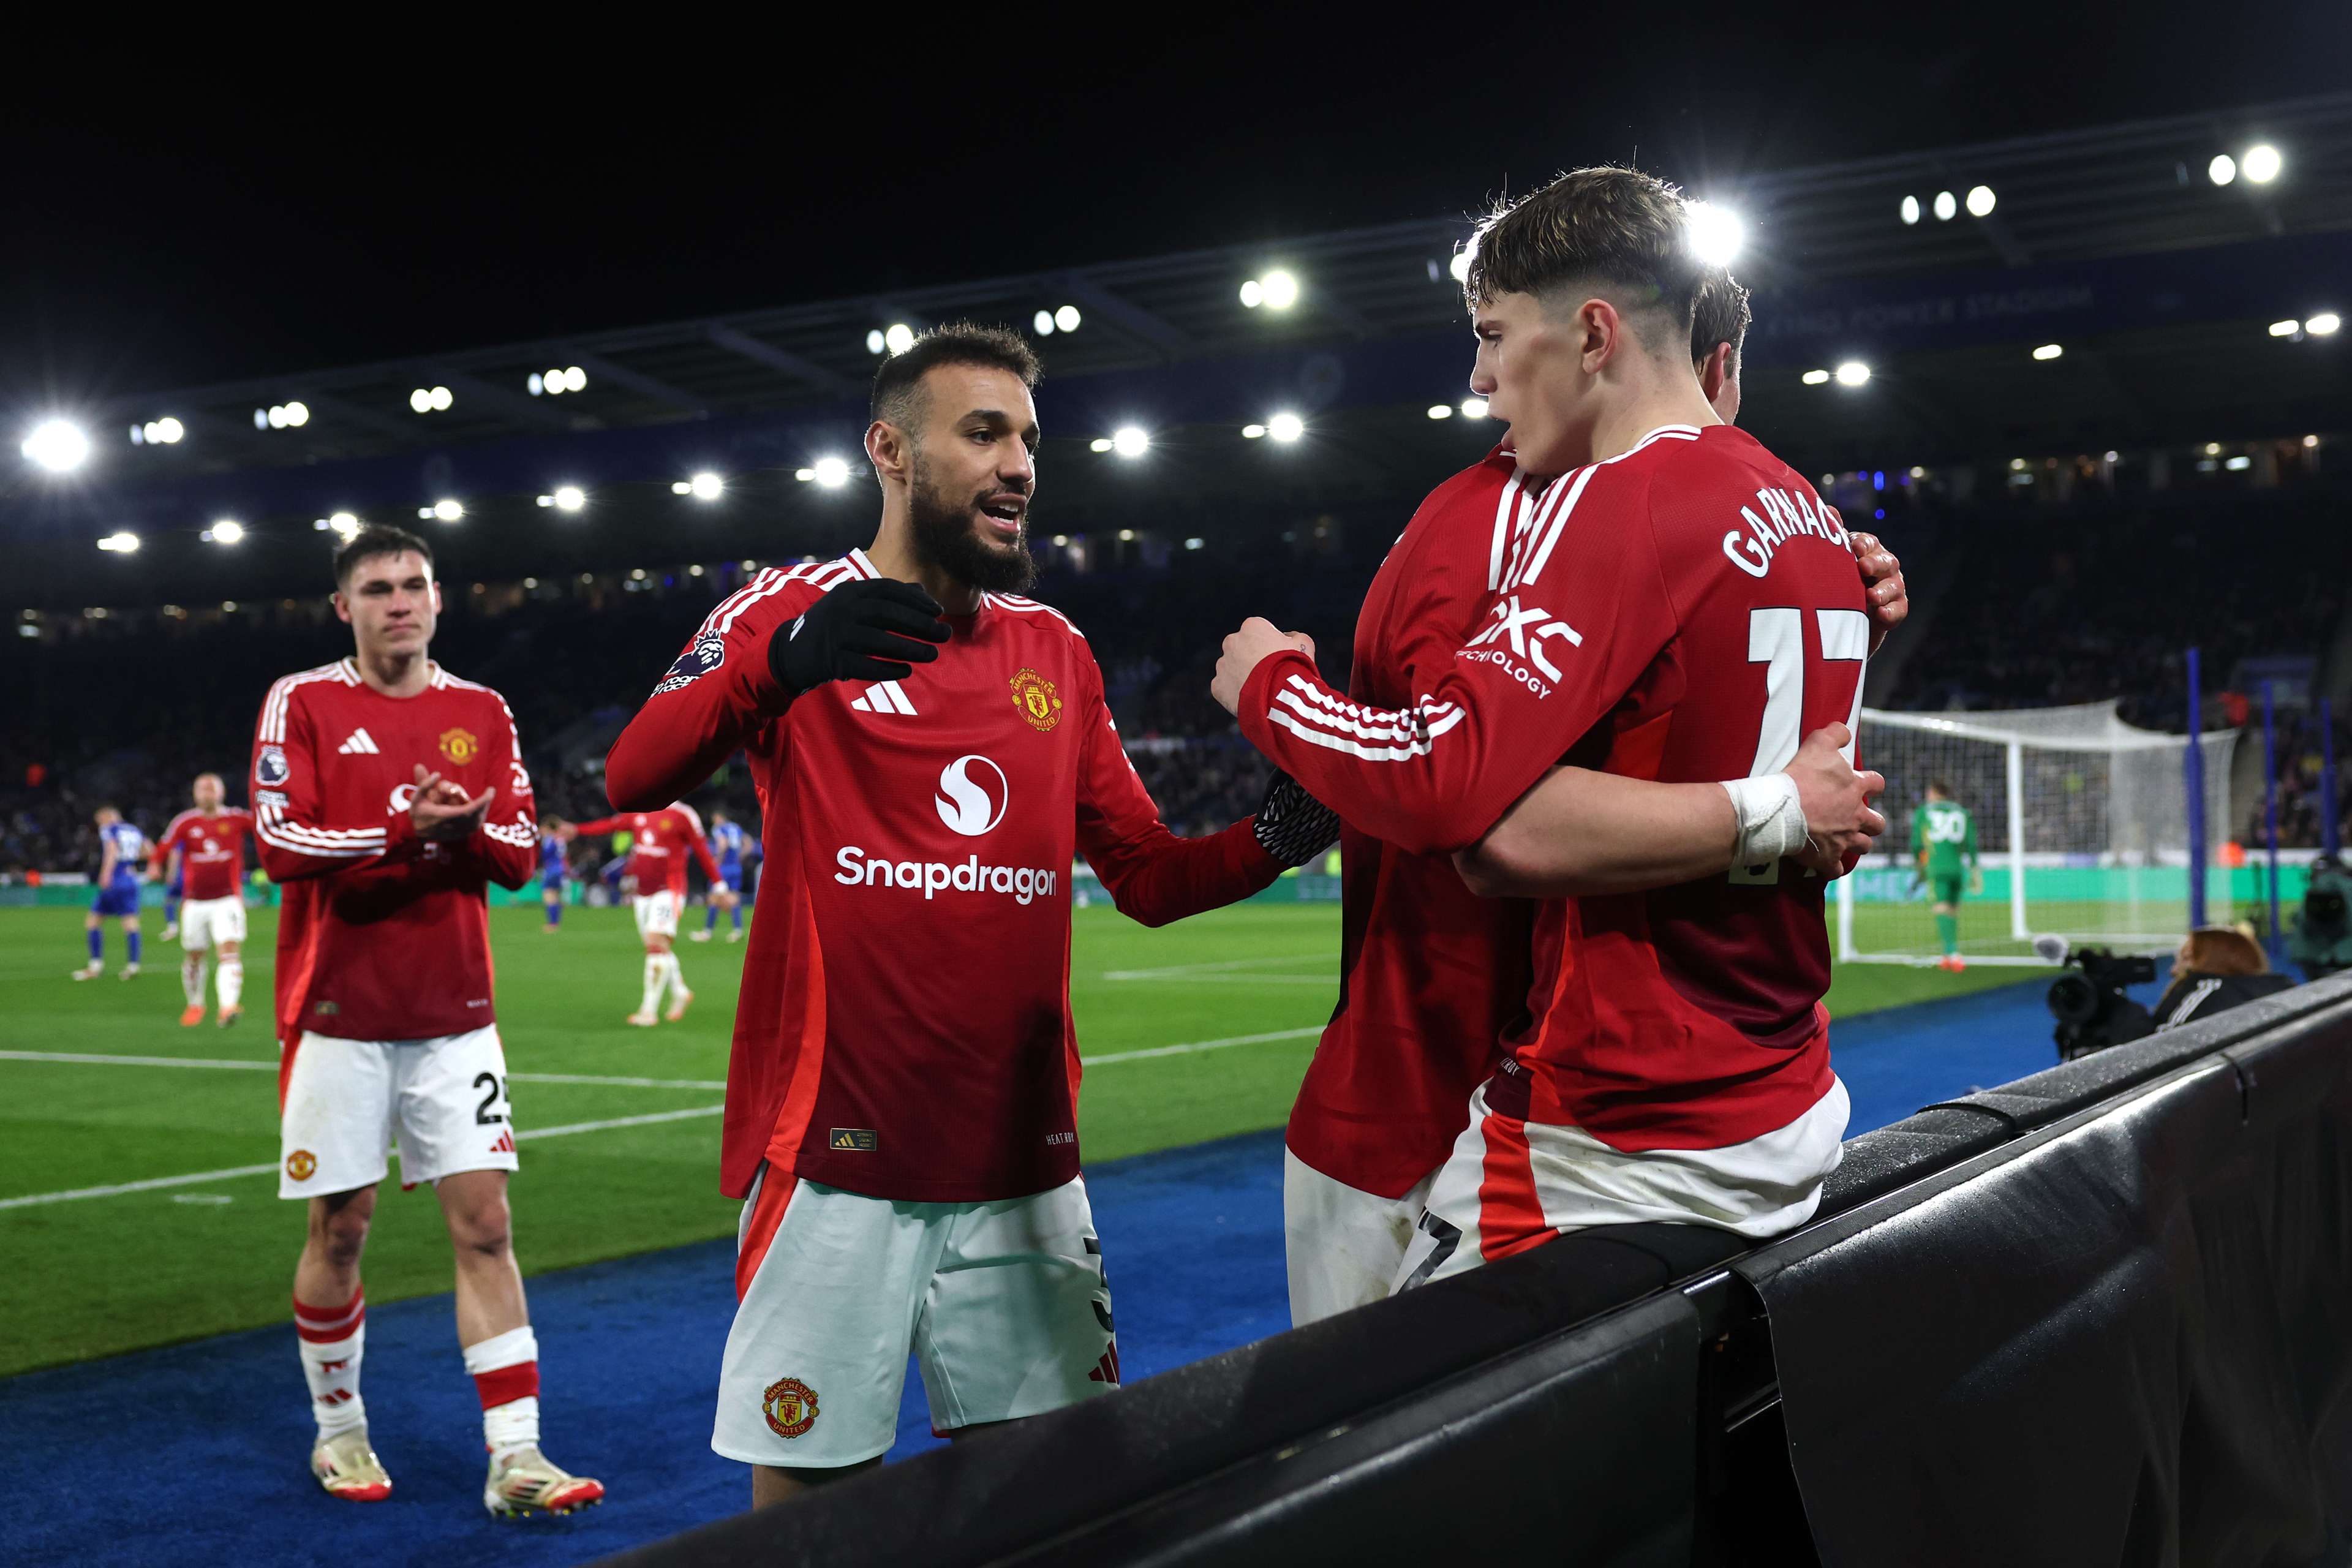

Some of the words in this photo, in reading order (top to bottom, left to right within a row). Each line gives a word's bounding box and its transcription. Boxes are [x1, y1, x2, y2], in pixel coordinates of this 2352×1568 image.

[1012, 672, 1053, 698] MANCHESTER
[1748, 606, 1869, 778] 17
[1027, 715, 1055, 726] UNITED
[1926, 810, 1966, 843] 30
[834, 846, 1057, 905] Snapdragon
[767, 1382, 813, 1403] MANCHESTER
[774, 1422, 805, 1433] UNITED
